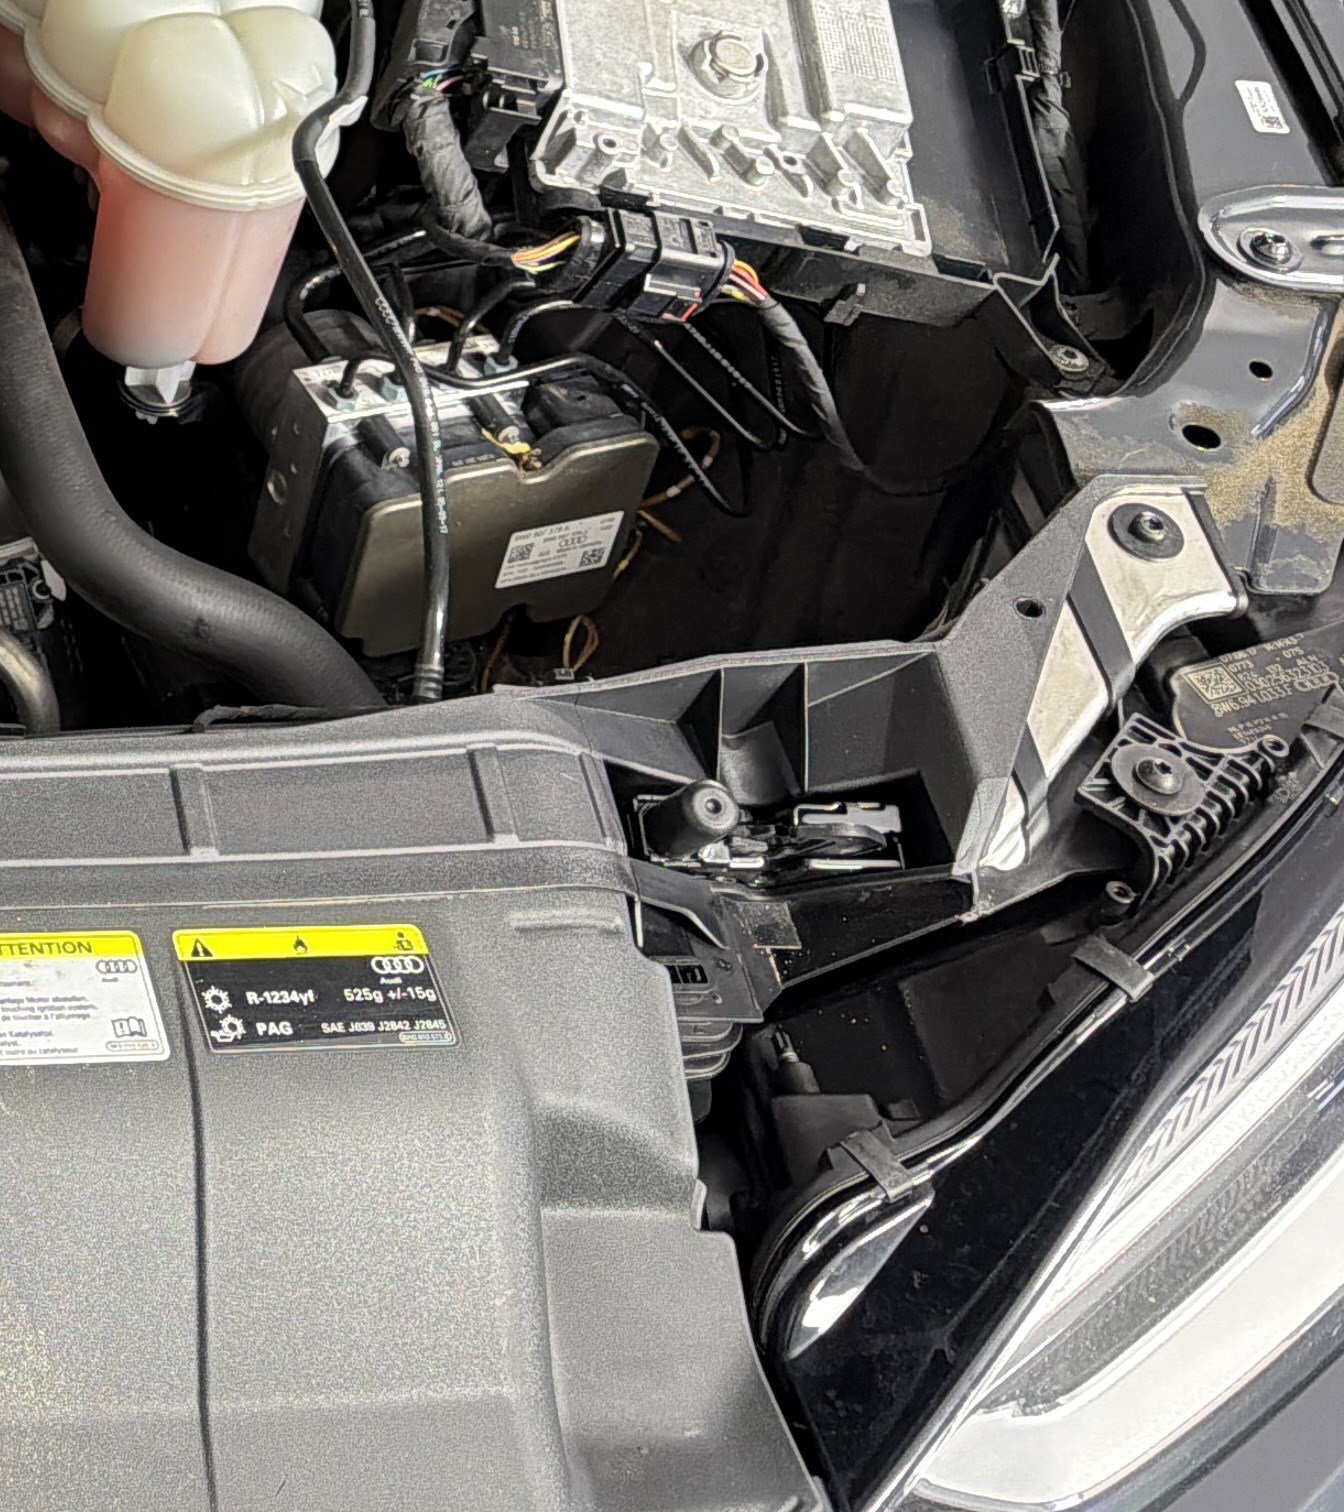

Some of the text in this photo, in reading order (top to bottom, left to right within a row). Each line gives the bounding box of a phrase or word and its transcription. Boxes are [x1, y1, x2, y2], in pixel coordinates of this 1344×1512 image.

[379, 976, 403, 985] Audi
[245, 986, 437, 1006] R-1234yf 525g +/-15g
[255, 1021, 294, 1036] PAG
[320, 1022, 346, 1034] SAE
